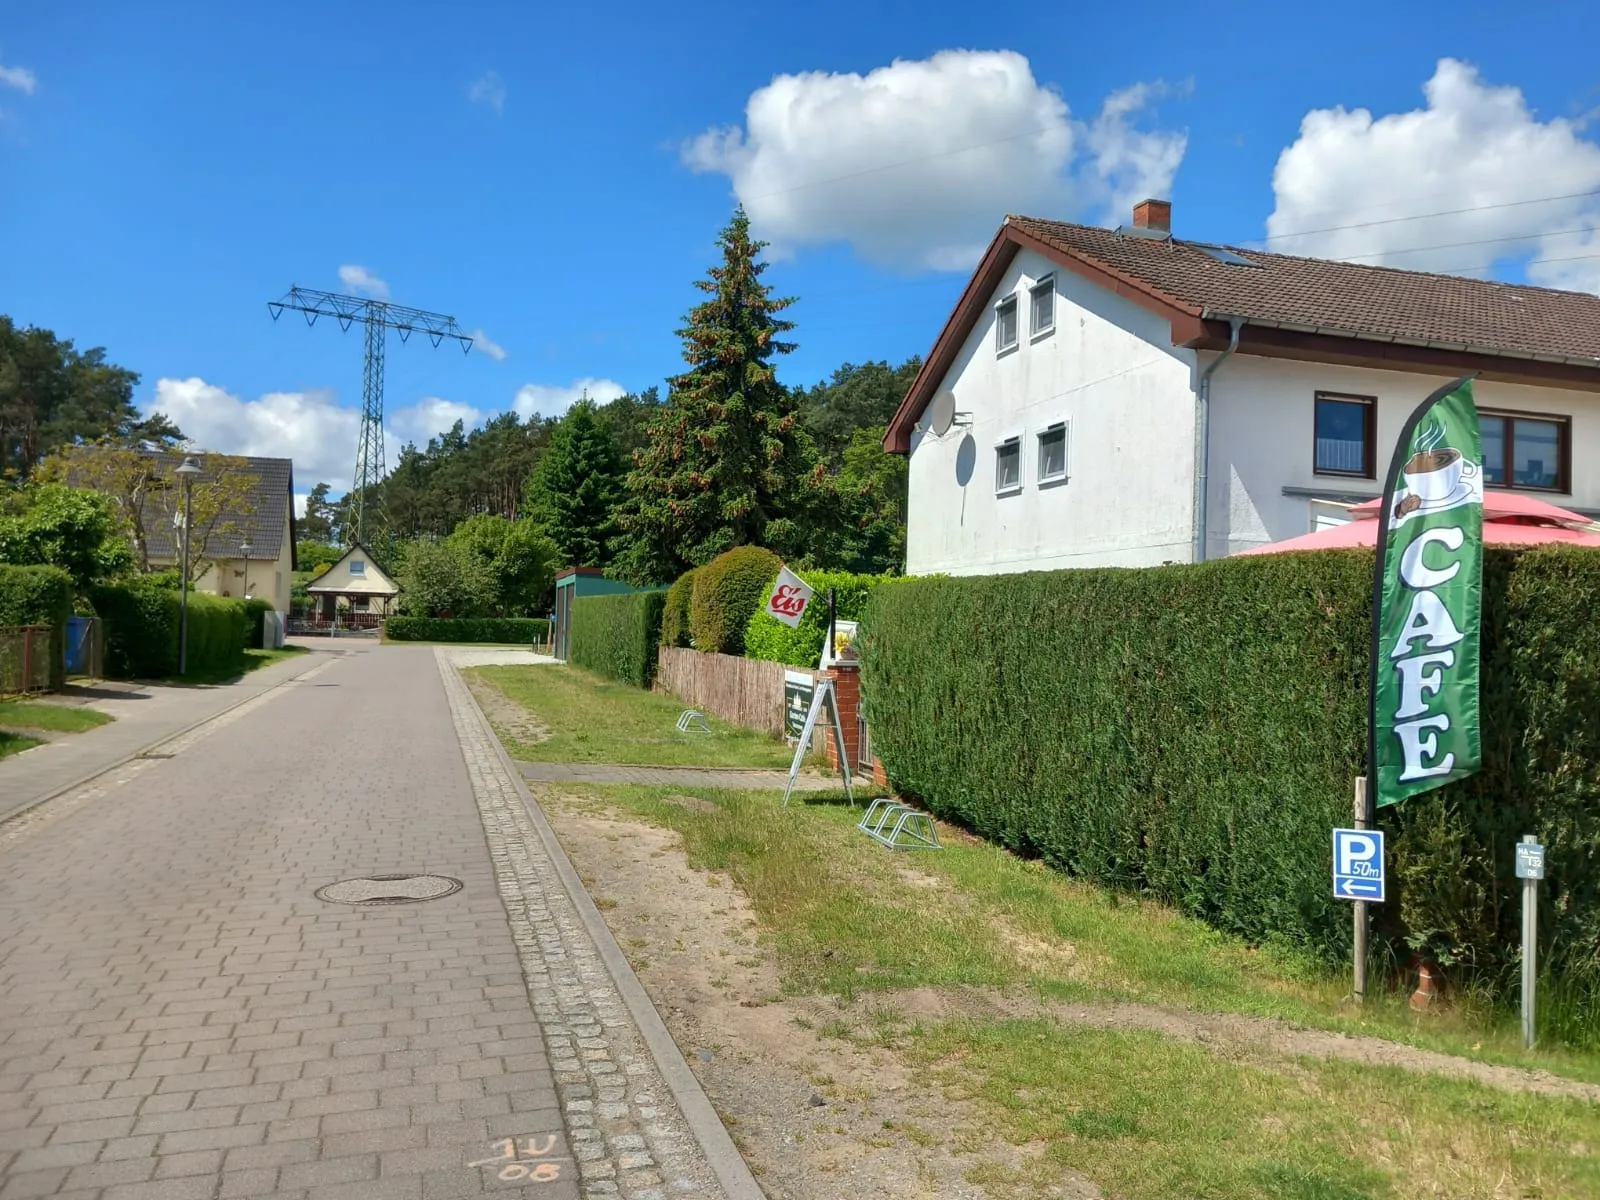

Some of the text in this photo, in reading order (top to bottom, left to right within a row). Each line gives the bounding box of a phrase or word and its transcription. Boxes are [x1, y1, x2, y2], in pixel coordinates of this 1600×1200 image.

[771, 585, 806, 613] Eis
[1389, 526, 1465, 783] CAFE
[1340, 834, 1376, 874] P
[1352, 861, 1379, 877] 50m
